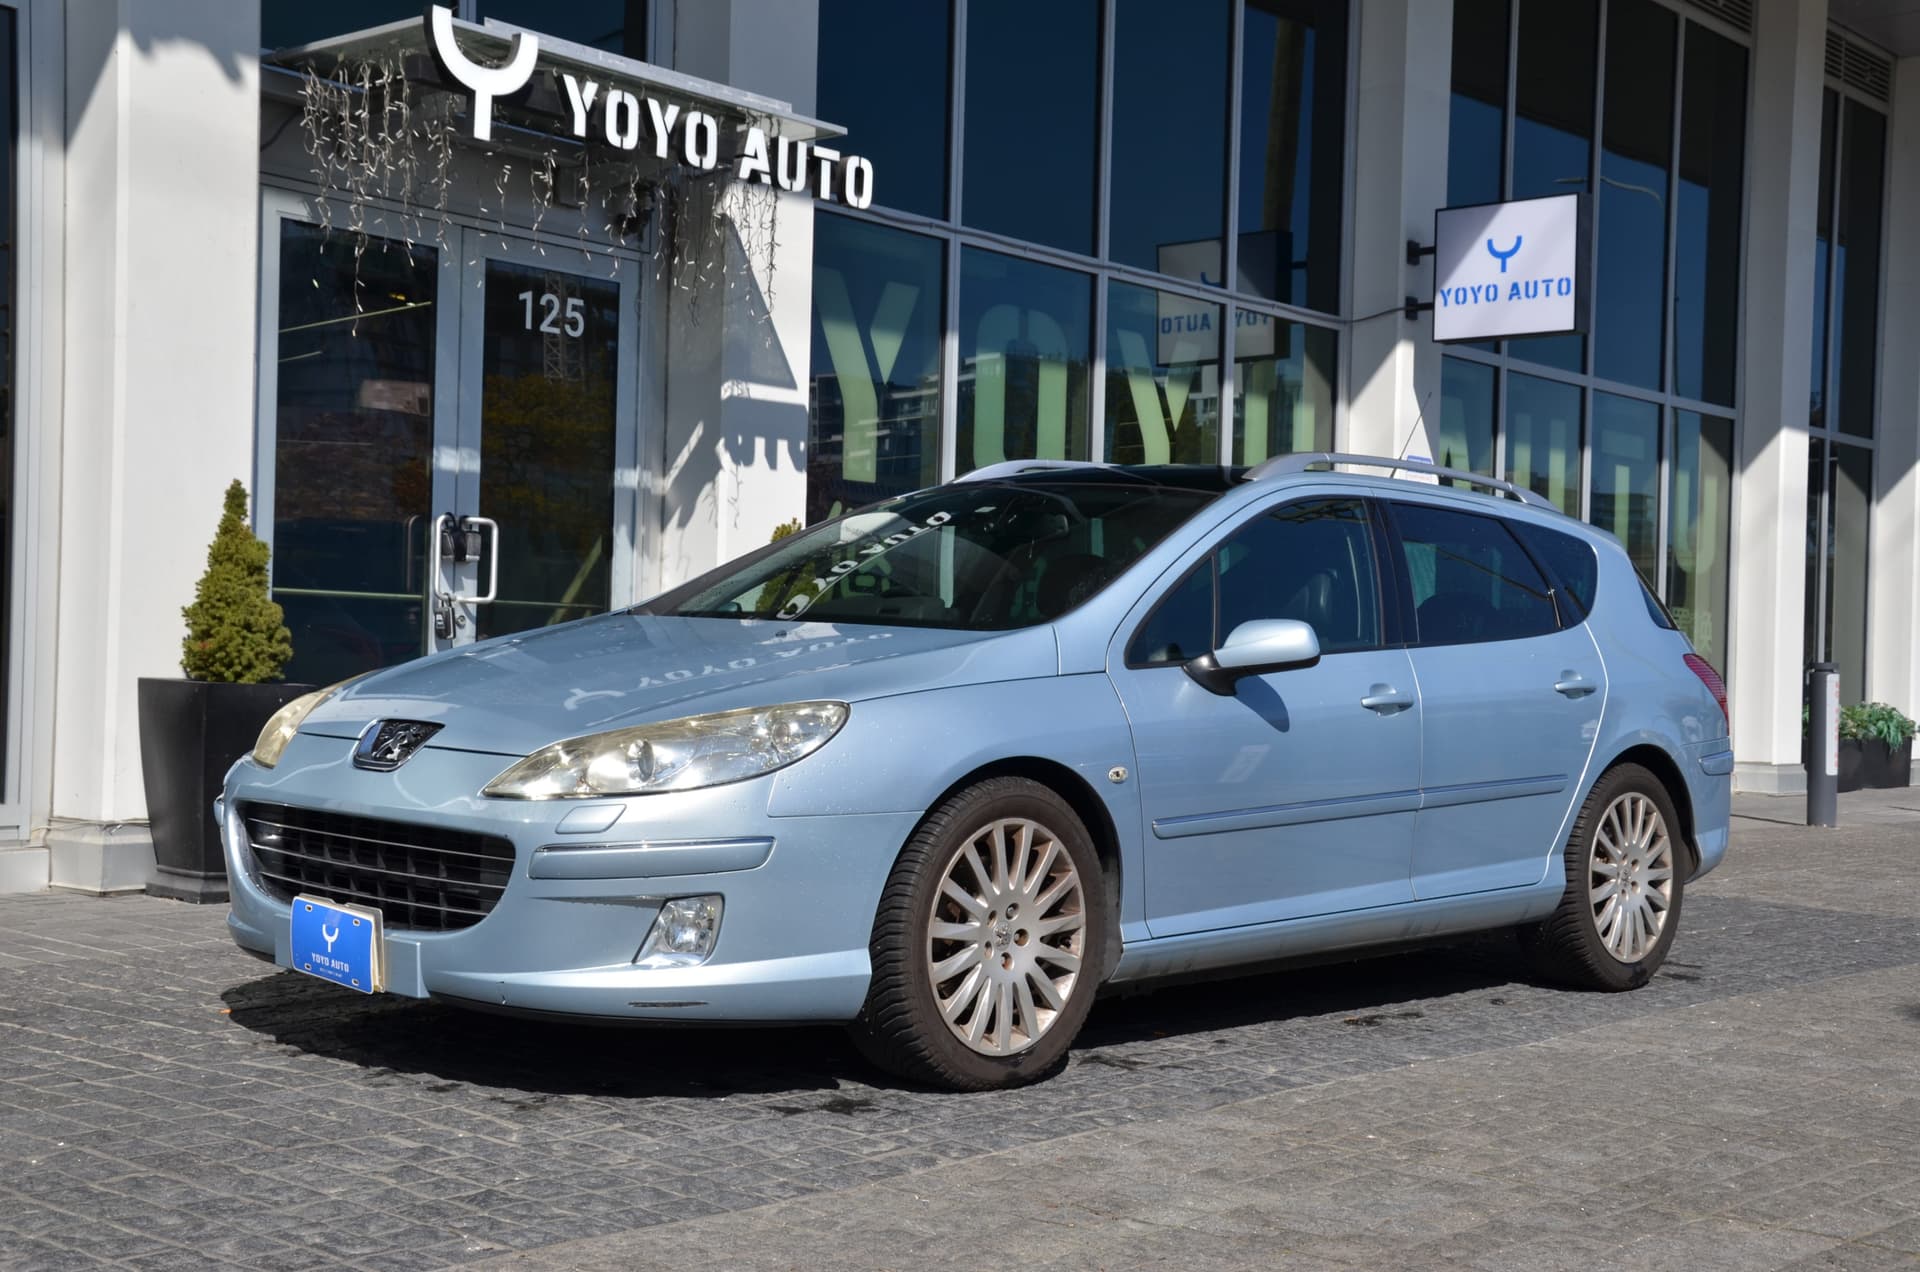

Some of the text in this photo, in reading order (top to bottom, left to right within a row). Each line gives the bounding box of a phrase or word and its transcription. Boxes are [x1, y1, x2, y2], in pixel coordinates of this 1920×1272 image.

[562, 73, 874, 209] YOYO AUTO
[1440, 277, 1572, 307] YOYO AUTO
[519, 291, 585, 338] 125
[311, 952, 330, 967] YOYO
[331, 959, 350, 973] AUTO
